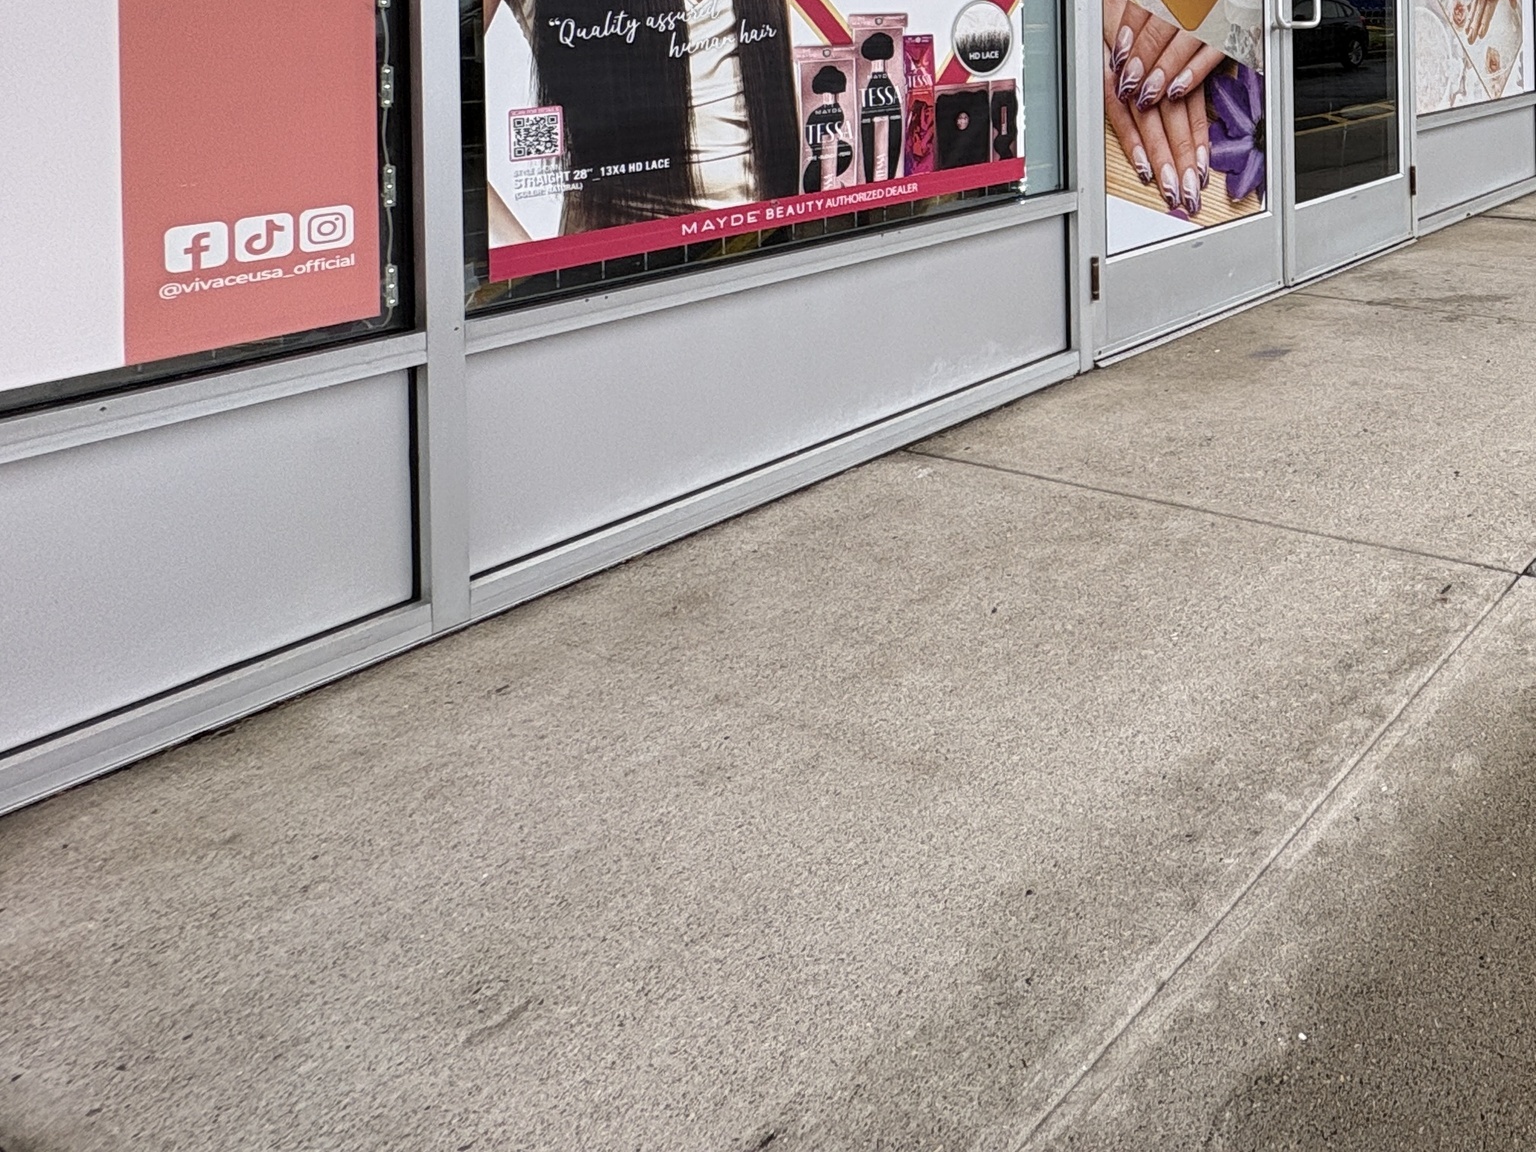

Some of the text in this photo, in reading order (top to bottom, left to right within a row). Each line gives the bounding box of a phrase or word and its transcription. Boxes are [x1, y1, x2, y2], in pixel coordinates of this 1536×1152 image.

[668, 18, 778, 58] human hair
[968, 50, 1000, 61] HD LACE
[859, 85, 903, 108] TESSA
[806, 120, 853, 145] TESSA
[514, 170, 571, 190] STRAIGHT
[628, 163, 643, 174] HD
[645, 158, 671, 171] LACE
[681, 182, 918, 236] MAYDE BEAUTY AUTHORIZED DEALER
[158, 253, 356, 300] @vivaceusa_official
